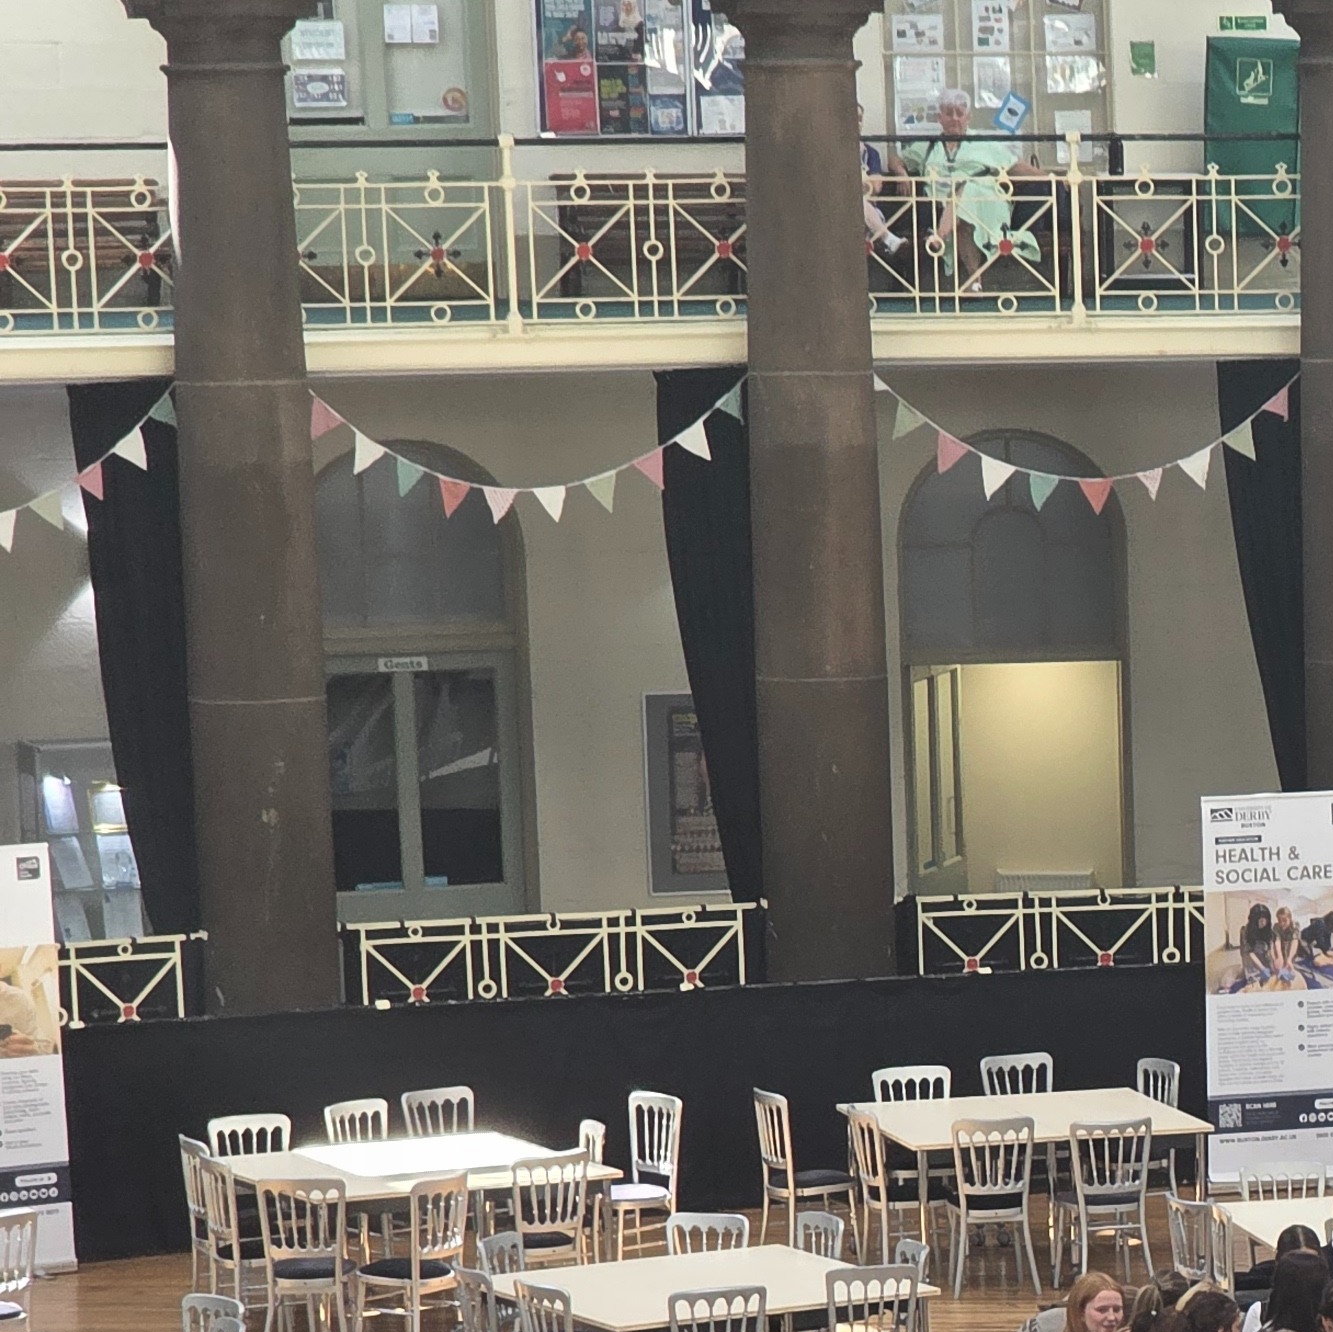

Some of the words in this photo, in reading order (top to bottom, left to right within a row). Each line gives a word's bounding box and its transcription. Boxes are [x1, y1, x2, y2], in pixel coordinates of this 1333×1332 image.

[1235, 810, 1272, 822] DERBY
[1215, 846, 1280, 864] HEALTH
[1288, 845, 1300, 861] &
[1215, 867, 1280, 885] SOCIAL
[1287, 864, 1333, 881] CARE
